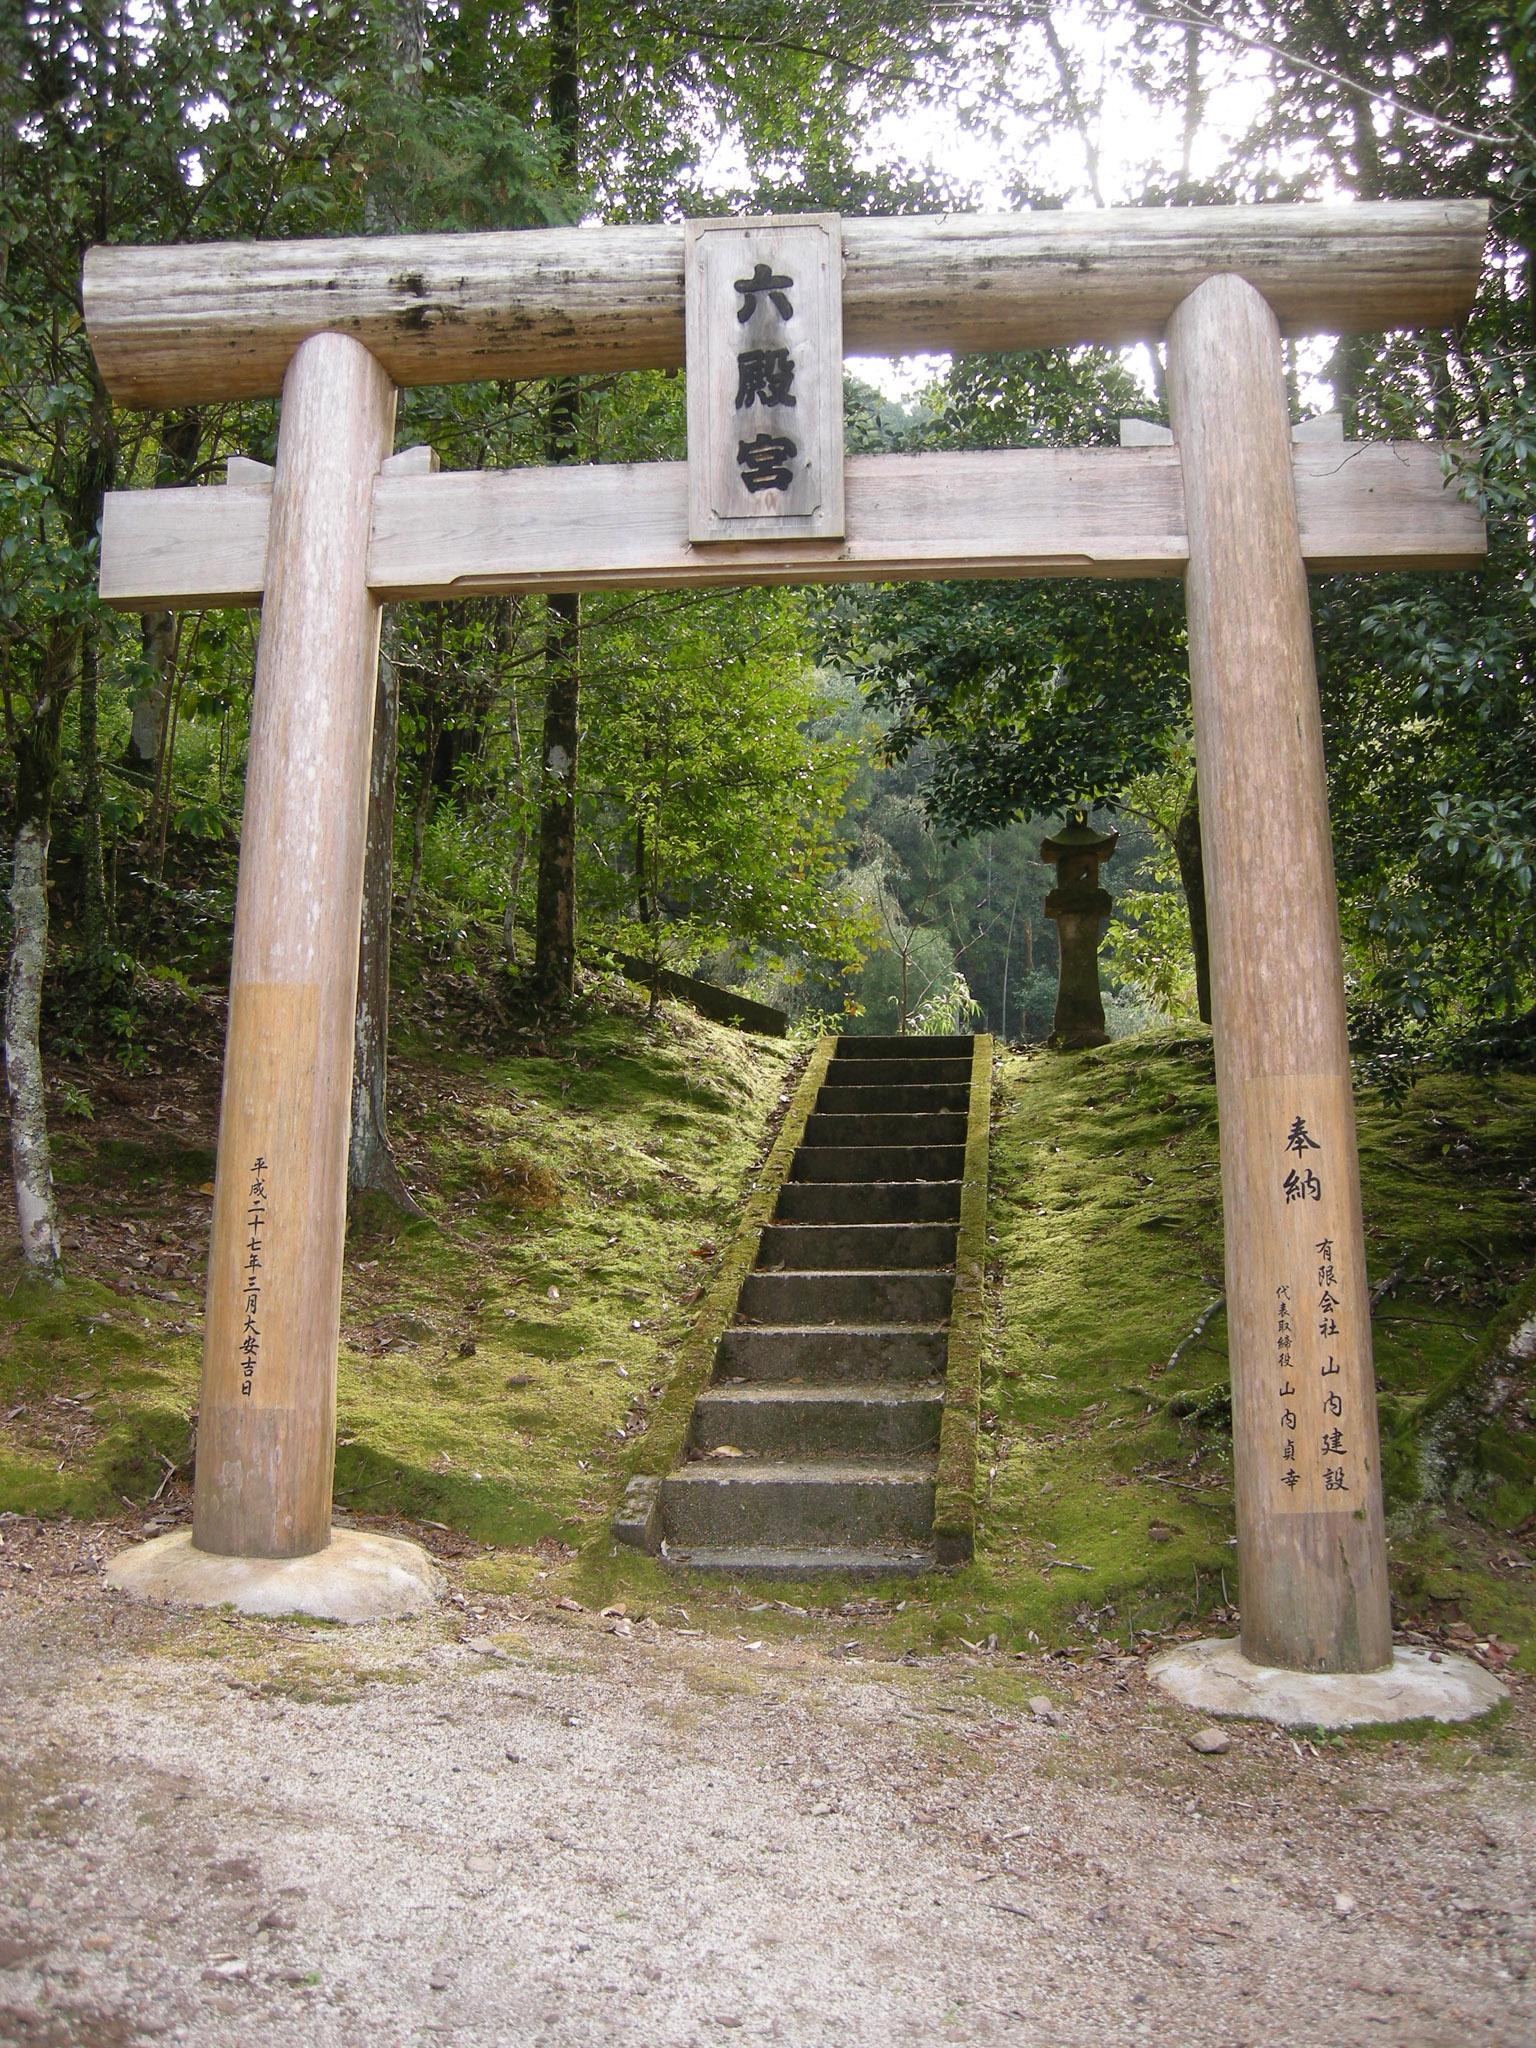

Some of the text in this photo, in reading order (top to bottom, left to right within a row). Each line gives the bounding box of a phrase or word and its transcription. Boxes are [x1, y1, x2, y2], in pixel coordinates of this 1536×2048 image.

[733, 263, 798, 494] 六殿宮
[1283, 1115, 1322, 1205] 奉納
[239, 1157, 269, 1397] 平成二十七年三月大安吉日
